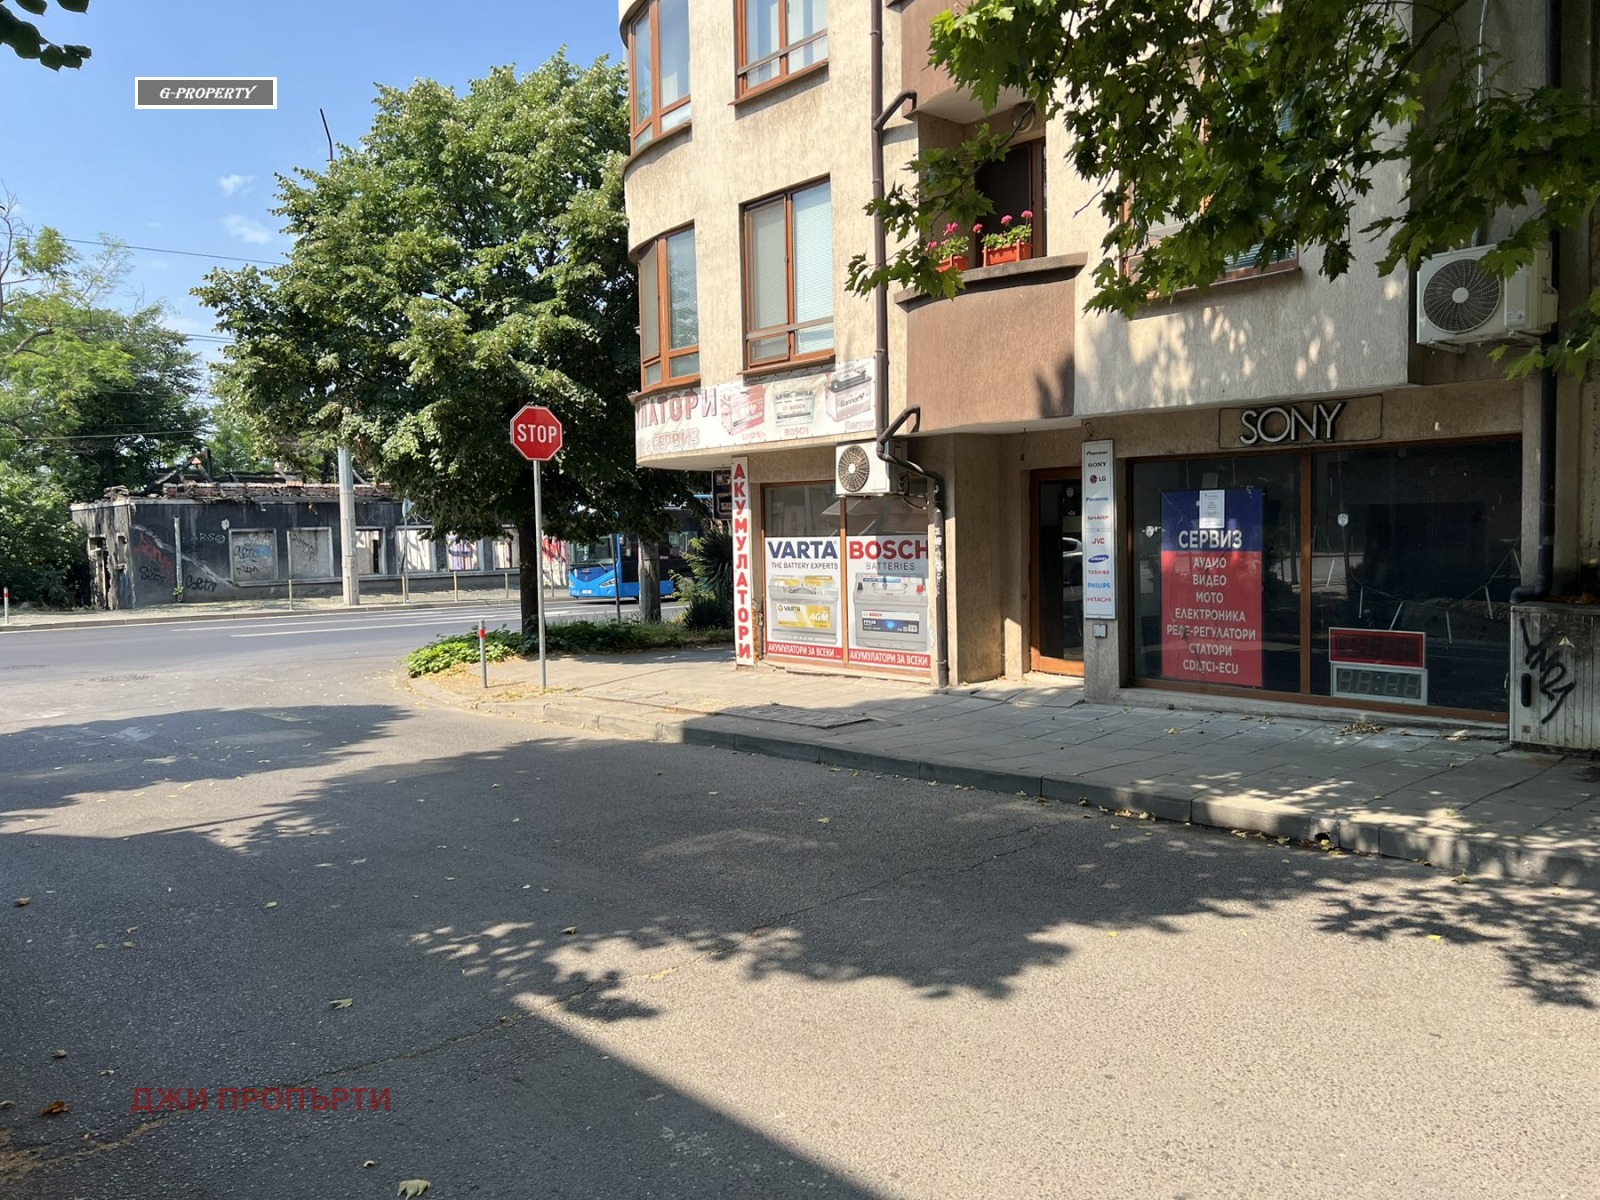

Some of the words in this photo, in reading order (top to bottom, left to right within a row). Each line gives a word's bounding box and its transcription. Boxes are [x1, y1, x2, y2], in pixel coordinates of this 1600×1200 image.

[1239, 402, 1345, 445] SONY
[517, 423, 557, 444] STOP
[652, 427, 700, 451] СЕРВИЗ
[1179, 530, 1242, 549] СЕРВИЗ
[767, 541, 838, 559] VARTA
[849, 540, 928, 559] BOSCH
[734, 464, 750, 659] АКУМУЛАТОРИ
[866, 562, 915, 570] BATTERIES
[1193, 557, 1227, 570] АУДИО
[1192, 574, 1227, 587] ВИДЕО
[1196, 592, 1224, 603] МОТО
[809, 613, 829, 621] AGM
[1175, 608, 1246, 622] ЕЛЕКТРОНИКА
[768, 643, 807, 656] АКУМУЛАТОРИ
[808, 646, 815, 656] ЗА
[816, 647, 834, 657] ВСЕКИ
[1189, 643, 1232, 656] СТАТОРИ
[849, 650, 896, 662] АКУМУЛАТОРИ
[897, 654, 905, 664] ЗА
[906, 654, 928, 666] ВСЕКИ
